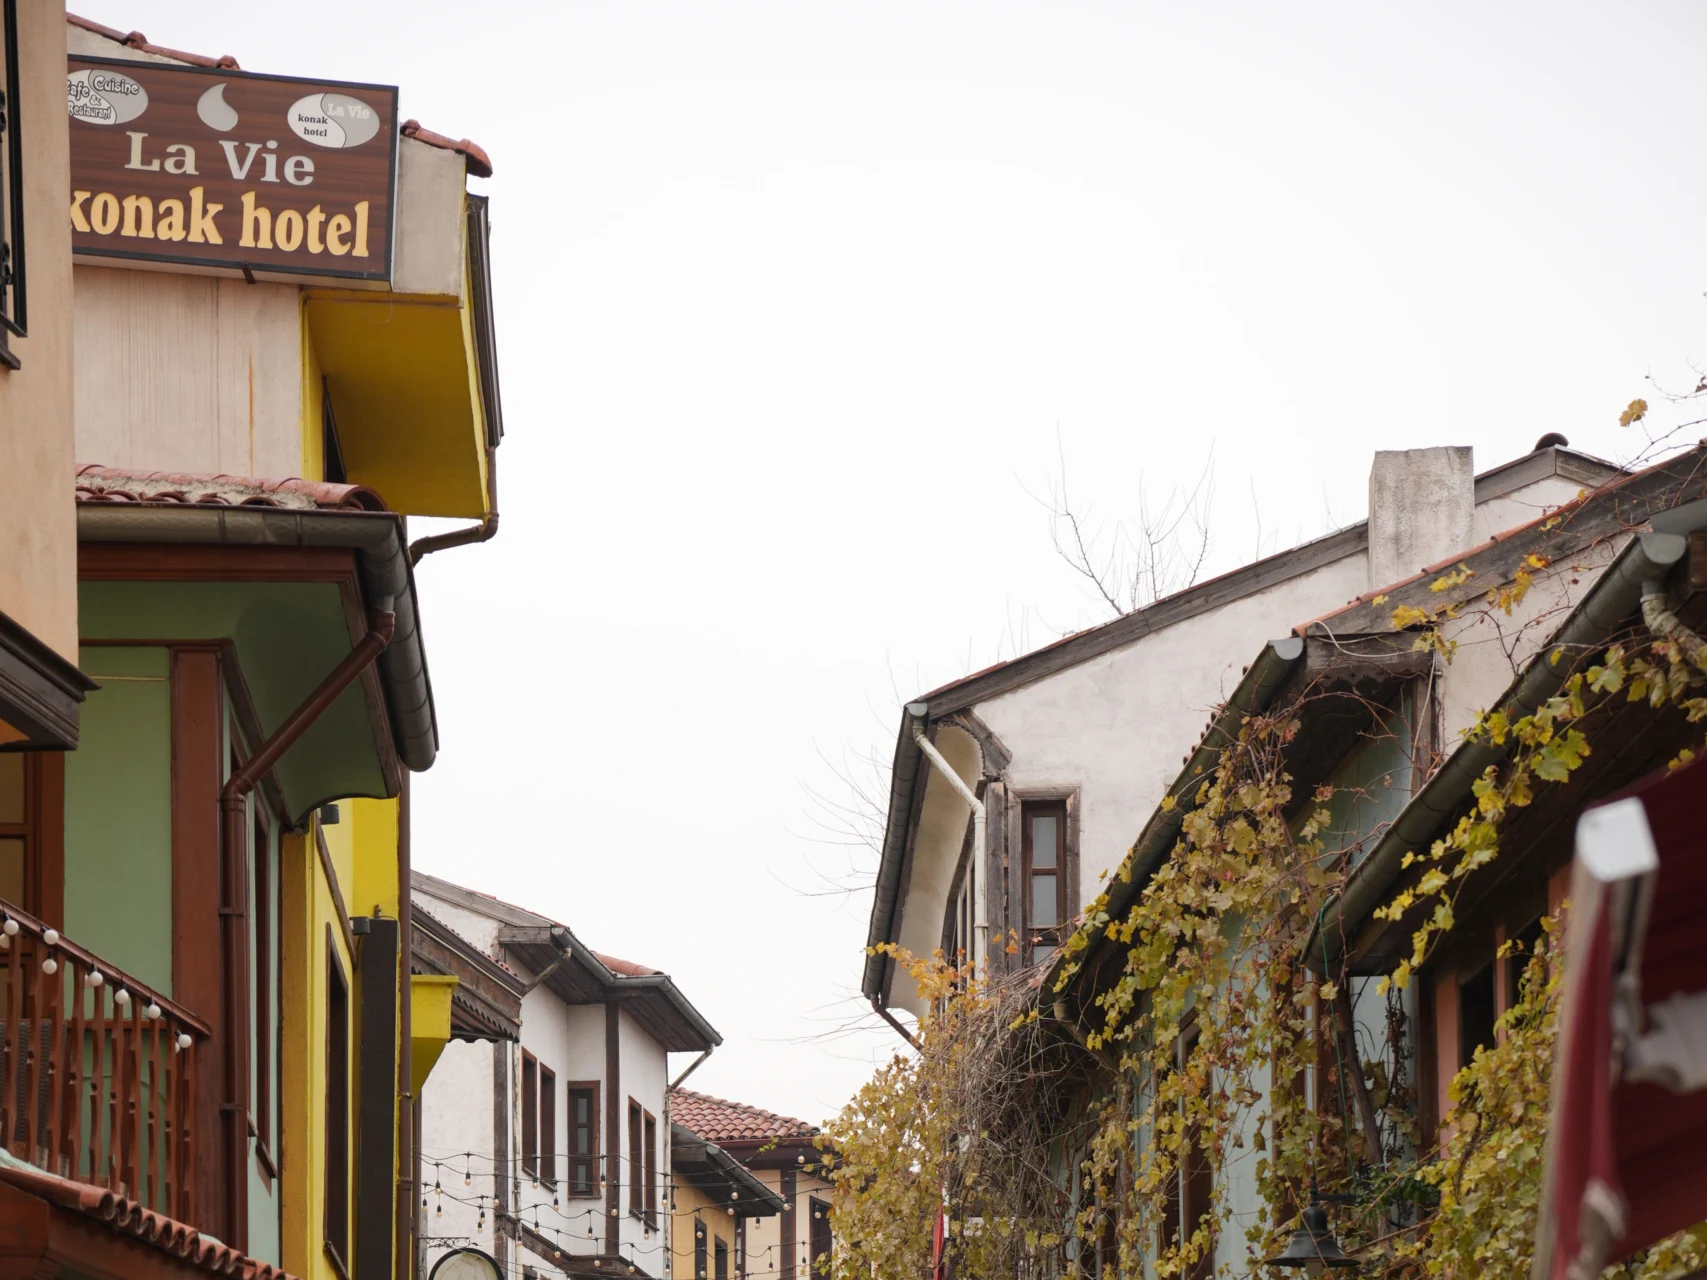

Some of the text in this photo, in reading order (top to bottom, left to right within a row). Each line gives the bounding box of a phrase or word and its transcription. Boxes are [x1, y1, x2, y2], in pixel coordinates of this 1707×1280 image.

[93, 75, 139, 96] Cuisine
[68, 100, 112, 120] Restaurant
[298, 114, 328, 124] konak
[327, 103, 370, 120] La Vie
[304, 127, 327, 137] hotel
[124, 131, 315, 186] La Vie
[239, 191, 369, 257] hotel
